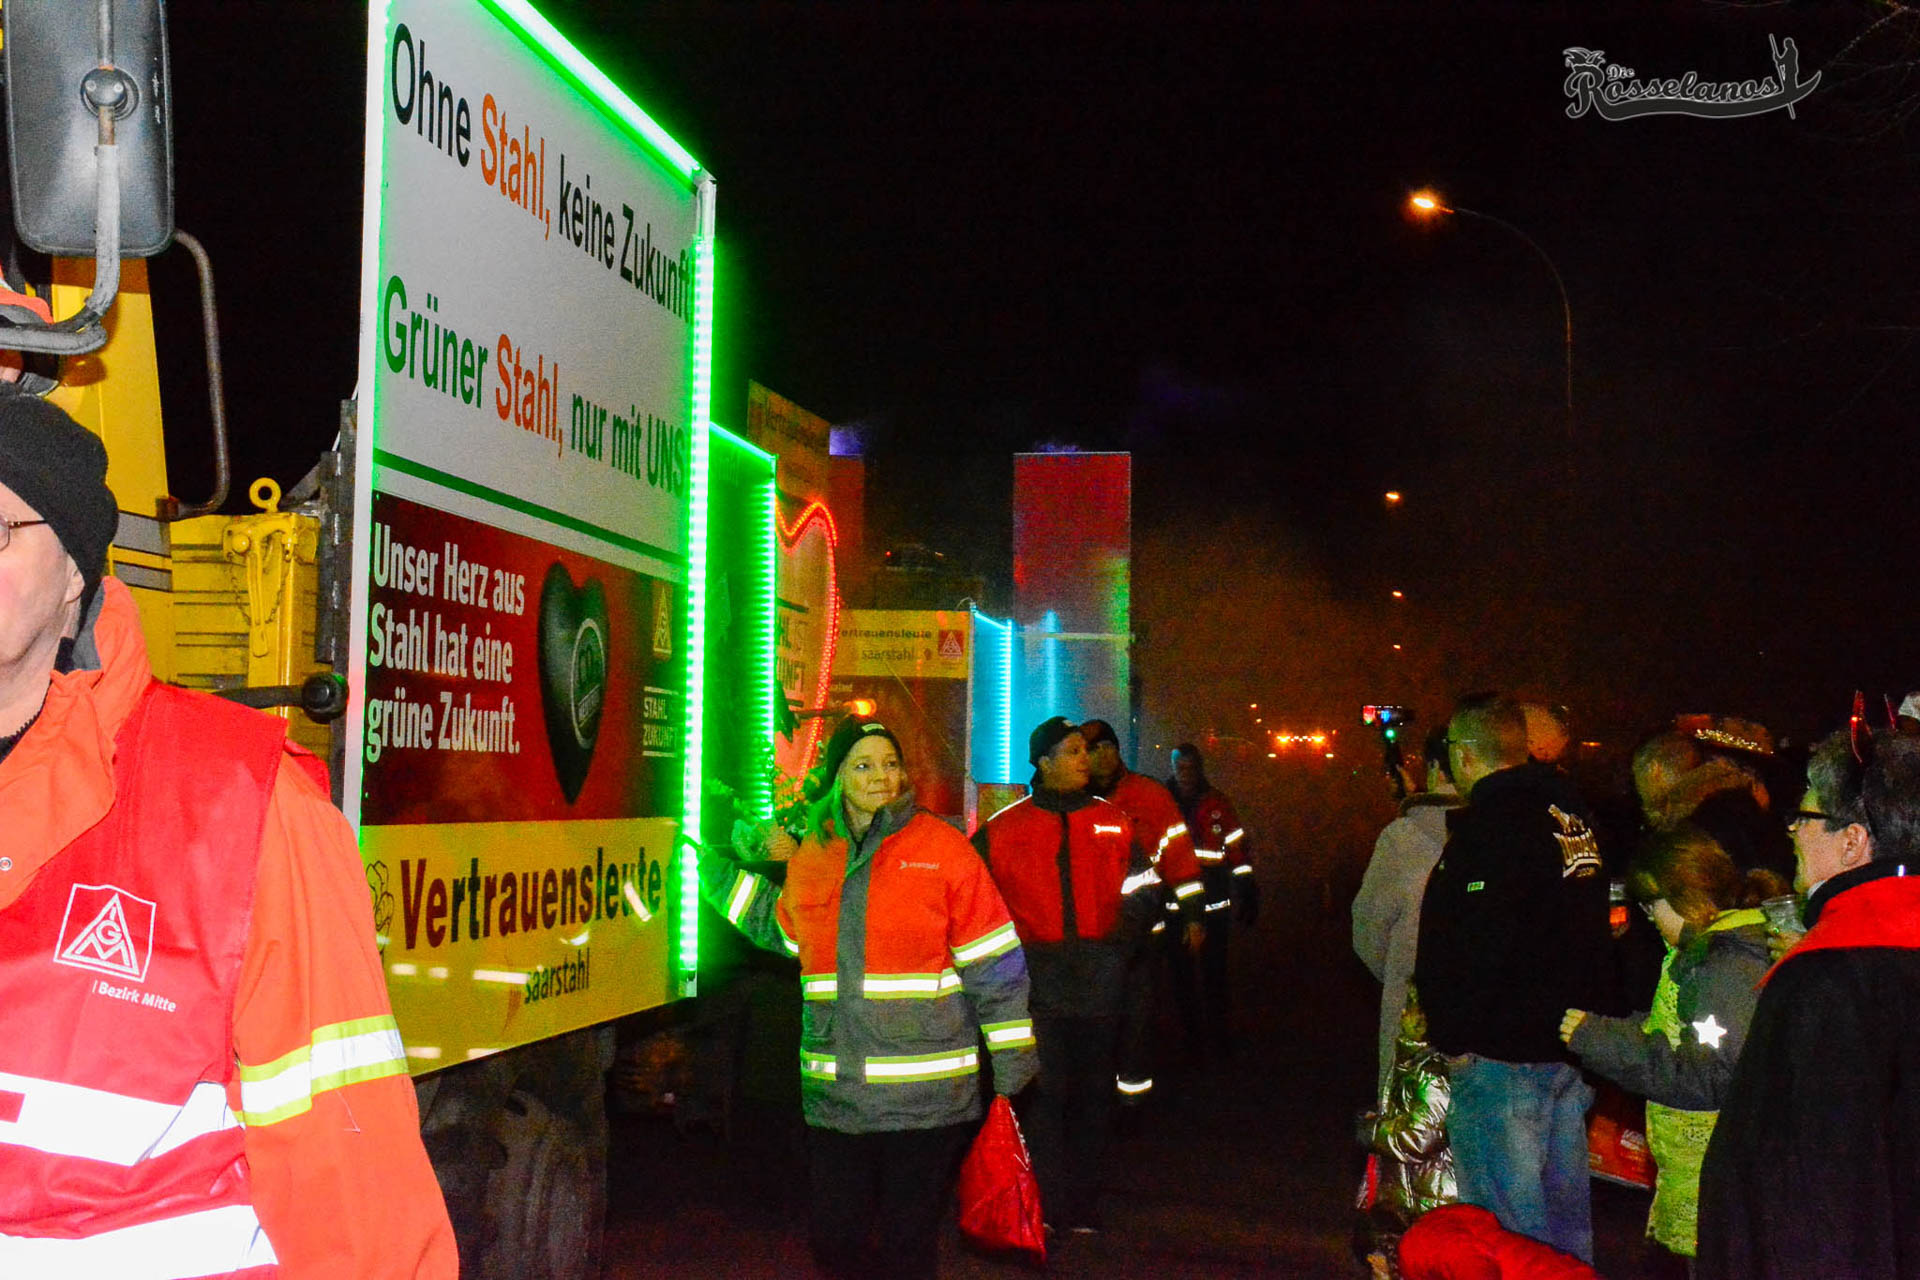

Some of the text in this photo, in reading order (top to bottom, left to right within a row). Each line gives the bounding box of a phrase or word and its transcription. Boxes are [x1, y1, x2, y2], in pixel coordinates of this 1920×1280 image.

[391, 23, 690, 324] Ohne Stahl, keine Zukunft
[383, 275, 488, 409] Grüner
[495, 333, 563, 459] Stahl,
[571, 393, 607, 462] nur
[611, 404, 641, 480] mit
[647, 413, 685, 499] UNS
[374, 522, 525, 616] Unser Herz aus
[370, 602, 513, 684] Stahl hat eine
[366, 686, 434, 763] grüne
[438, 690, 521, 754] Zukunft.
[400, 846, 662, 951] Vertrauensleute
[98, 980, 177, 1013] Bezirk Mitte
[524, 947, 591, 1004] saarstahl
